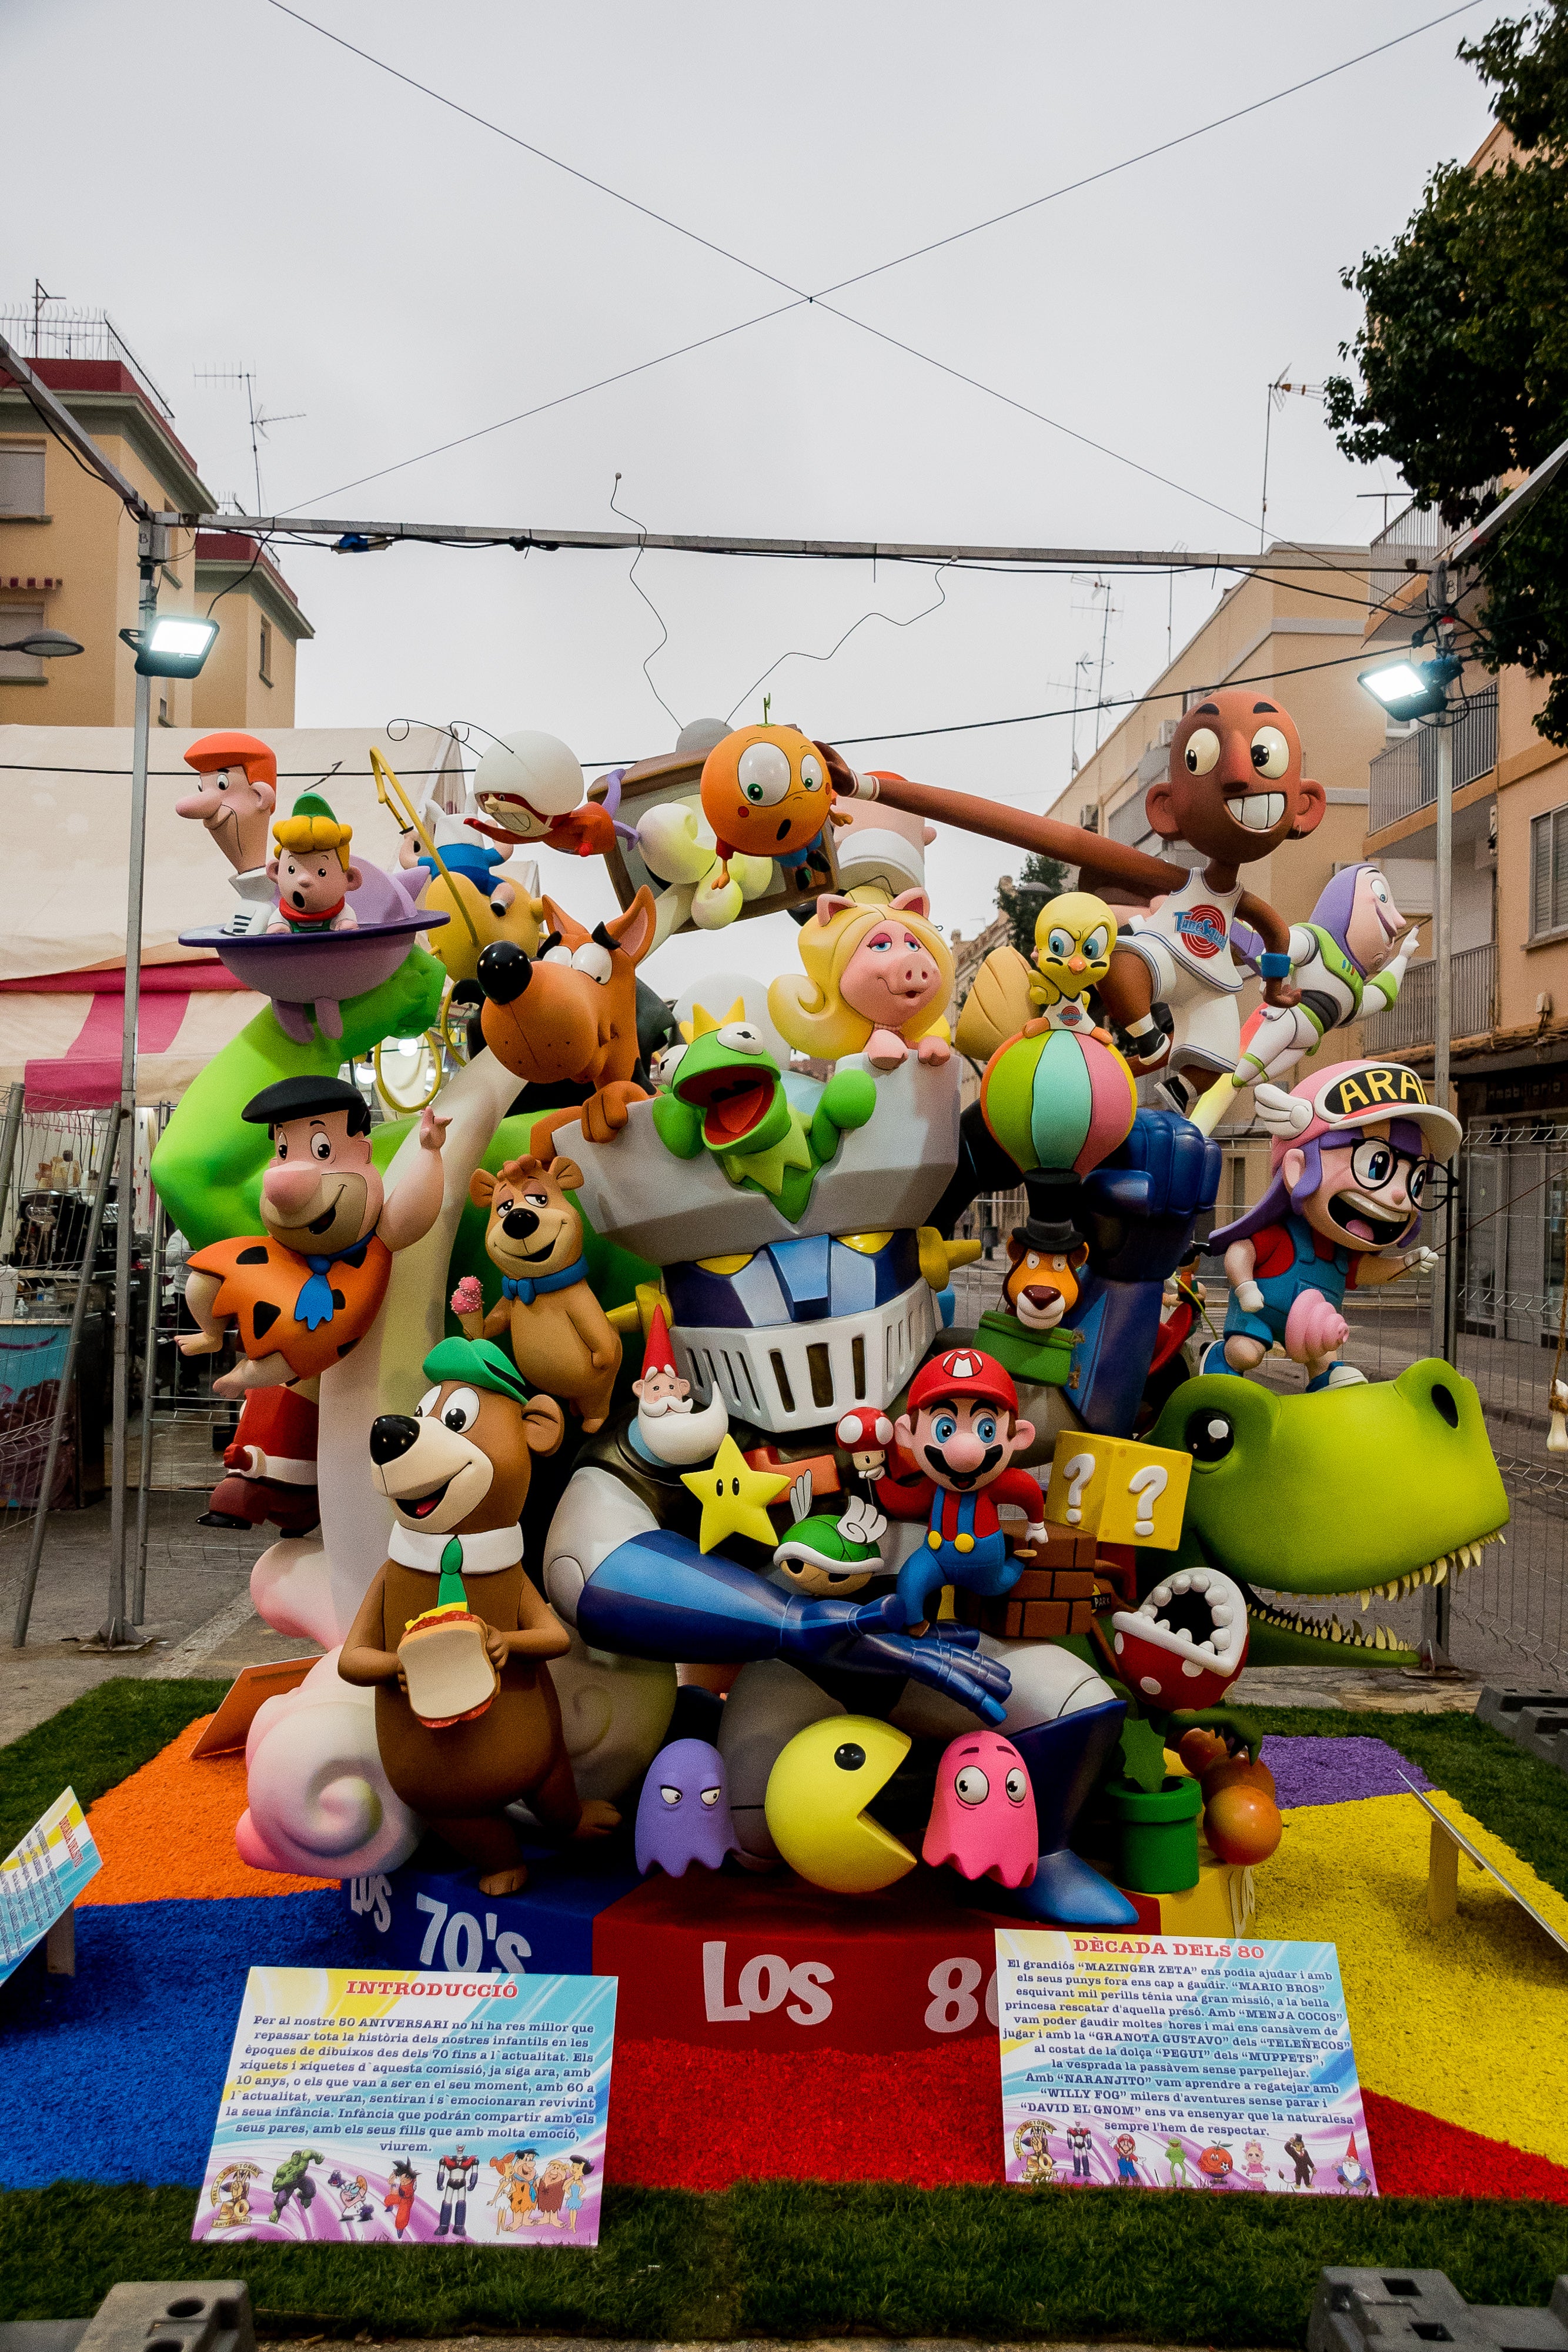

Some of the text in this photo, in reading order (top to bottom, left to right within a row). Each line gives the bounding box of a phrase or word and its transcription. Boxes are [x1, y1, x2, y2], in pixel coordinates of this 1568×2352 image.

[1074, 1935, 1263, 1957] DÈCADA DELS 80
[1007, 1959, 1020, 1967] El
[1223, 1968, 1256, 1977] podia
[1259, 1969, 1297, 1980] ajudar
[1300, 1970, 1304, 1979] i
[347, 1981, 516, 1997] INTRODUCCIÓ
[1017, 1973, 1034, 1982] els
[1065, 1977, 1101, 1986] punys
[1104, 1977, 1128, 1986] fora
[1154, 1980, 1174, 1989] cap
[1187, 1980, 1228, 1990] gaudir.
[1016, 1987, 1075, 1997] esquivant
[1078, 1989, 1097, 1998] mil
[1101, 1990, 1139, 2000] perills
[1201, 1995, 1229, 2004] gran
[1286, 1997, 1298, 2006] la
[1300, 1998, 1329, 2007] bella
[1005, 2000, 1056, 2010] princesa
[1059, 2004, 1109, 2013] rescatar
[1208, 2008, 1236, 2017] Amb
[253, 2016, 276, 2024] Per
[279, 2016, 290, 2024] al
[294, 2017, 335, 2026] nostre
[339, 2018, 355, 2026] 50
[358, 2018, 449, 2029] ANIVERSARI
[470, 2021, 483, 2030] hi
[487, 2022, 502, 2030] ha
[529, 2022, 569, 2032] millor
[571, 2025, 593, 2034] que
[1043, 2016, 1076, 2026] poder
[1080, 2017, 1119, 2028] gaudir
[1122, 2019, 1162, 2029] moltes
[1168, 2020, 1201, 2030] hores
[1205, 2021, 1209, 2030] i
[1212, 2022, 1235, 2031] mai
[1324, 2027, 1338, 2036] de
[254, 2032, 310, 2042] repassar
[314, 2033, 338, 2041] tota
[342, 2032, 354, 2041] la
[412, 2034, 438, 2043] dels
[442, 2036, 489, 2044] nostres
[493, 2036, 548, 2046] infantils
[570, 2038, 588, 2047] les
[1003, 2028, 1035, 2040] jugar
[1038, 2029, 1042, 2038] i
[1045, 2030, 1071, 2039] amb
[1074, 2031, 1085, 2040] la
[1232, 2037, 1257, 2046] dels
[1034, 2044, 1045, 2053] al
[1048, 2046, 1085, 2054] costat
[1088, 2046, 1102, 2054] de
[1105, 2046, 1117, 2056] la
[1213, 2050, 1238, 2060] dels
[1052, 2059, 1063, 2068] la
[1065, 2061, 1122, 2071] vesprada
[1125, 2062, 1136, 2070] la
[1202, 2066, 1236, 2074] sense
[1239, 2067, 1309, 2079] parpellejar.
[1025, 2072, 1054, 2082] Amb
[1185, 2080, 1241, 2090] aprendre
[1254, 2082, 1310, 2094] regatejar
[1312, 2083, 1339, 2093] amb
[226, 2107, 238, 2116] la
[398, 2112, 420, 2121] que
[474, 2112, 541, 2123] compartir
[544, 2112, 574, 2123] amb
[576, 2113, 594, 2124] els
[1072, 2104, 1091, 2113] EL
[1145, 2109, 1166, 2117] ens
[1187, 2110, 1244, 2122] ensenyar
[1248, 2113, 1269, 2122] que
[1272, 2112, 1283, 2121] la
[1286, 2113, 1353, 2124] naturalesa
[268, 2125, 308, 2136] pares,
[313, 2124, 341, 2133] amb
[345, 2124, 363, 2134] els
[399, 2125, 425, 2135] fills
[429, 2128, 452, 2137] que
[455, 2127, 484, 2136] amb
[487, 2128, 525, 2137] molta
[380, 2140, 432, 2151] viurem.
